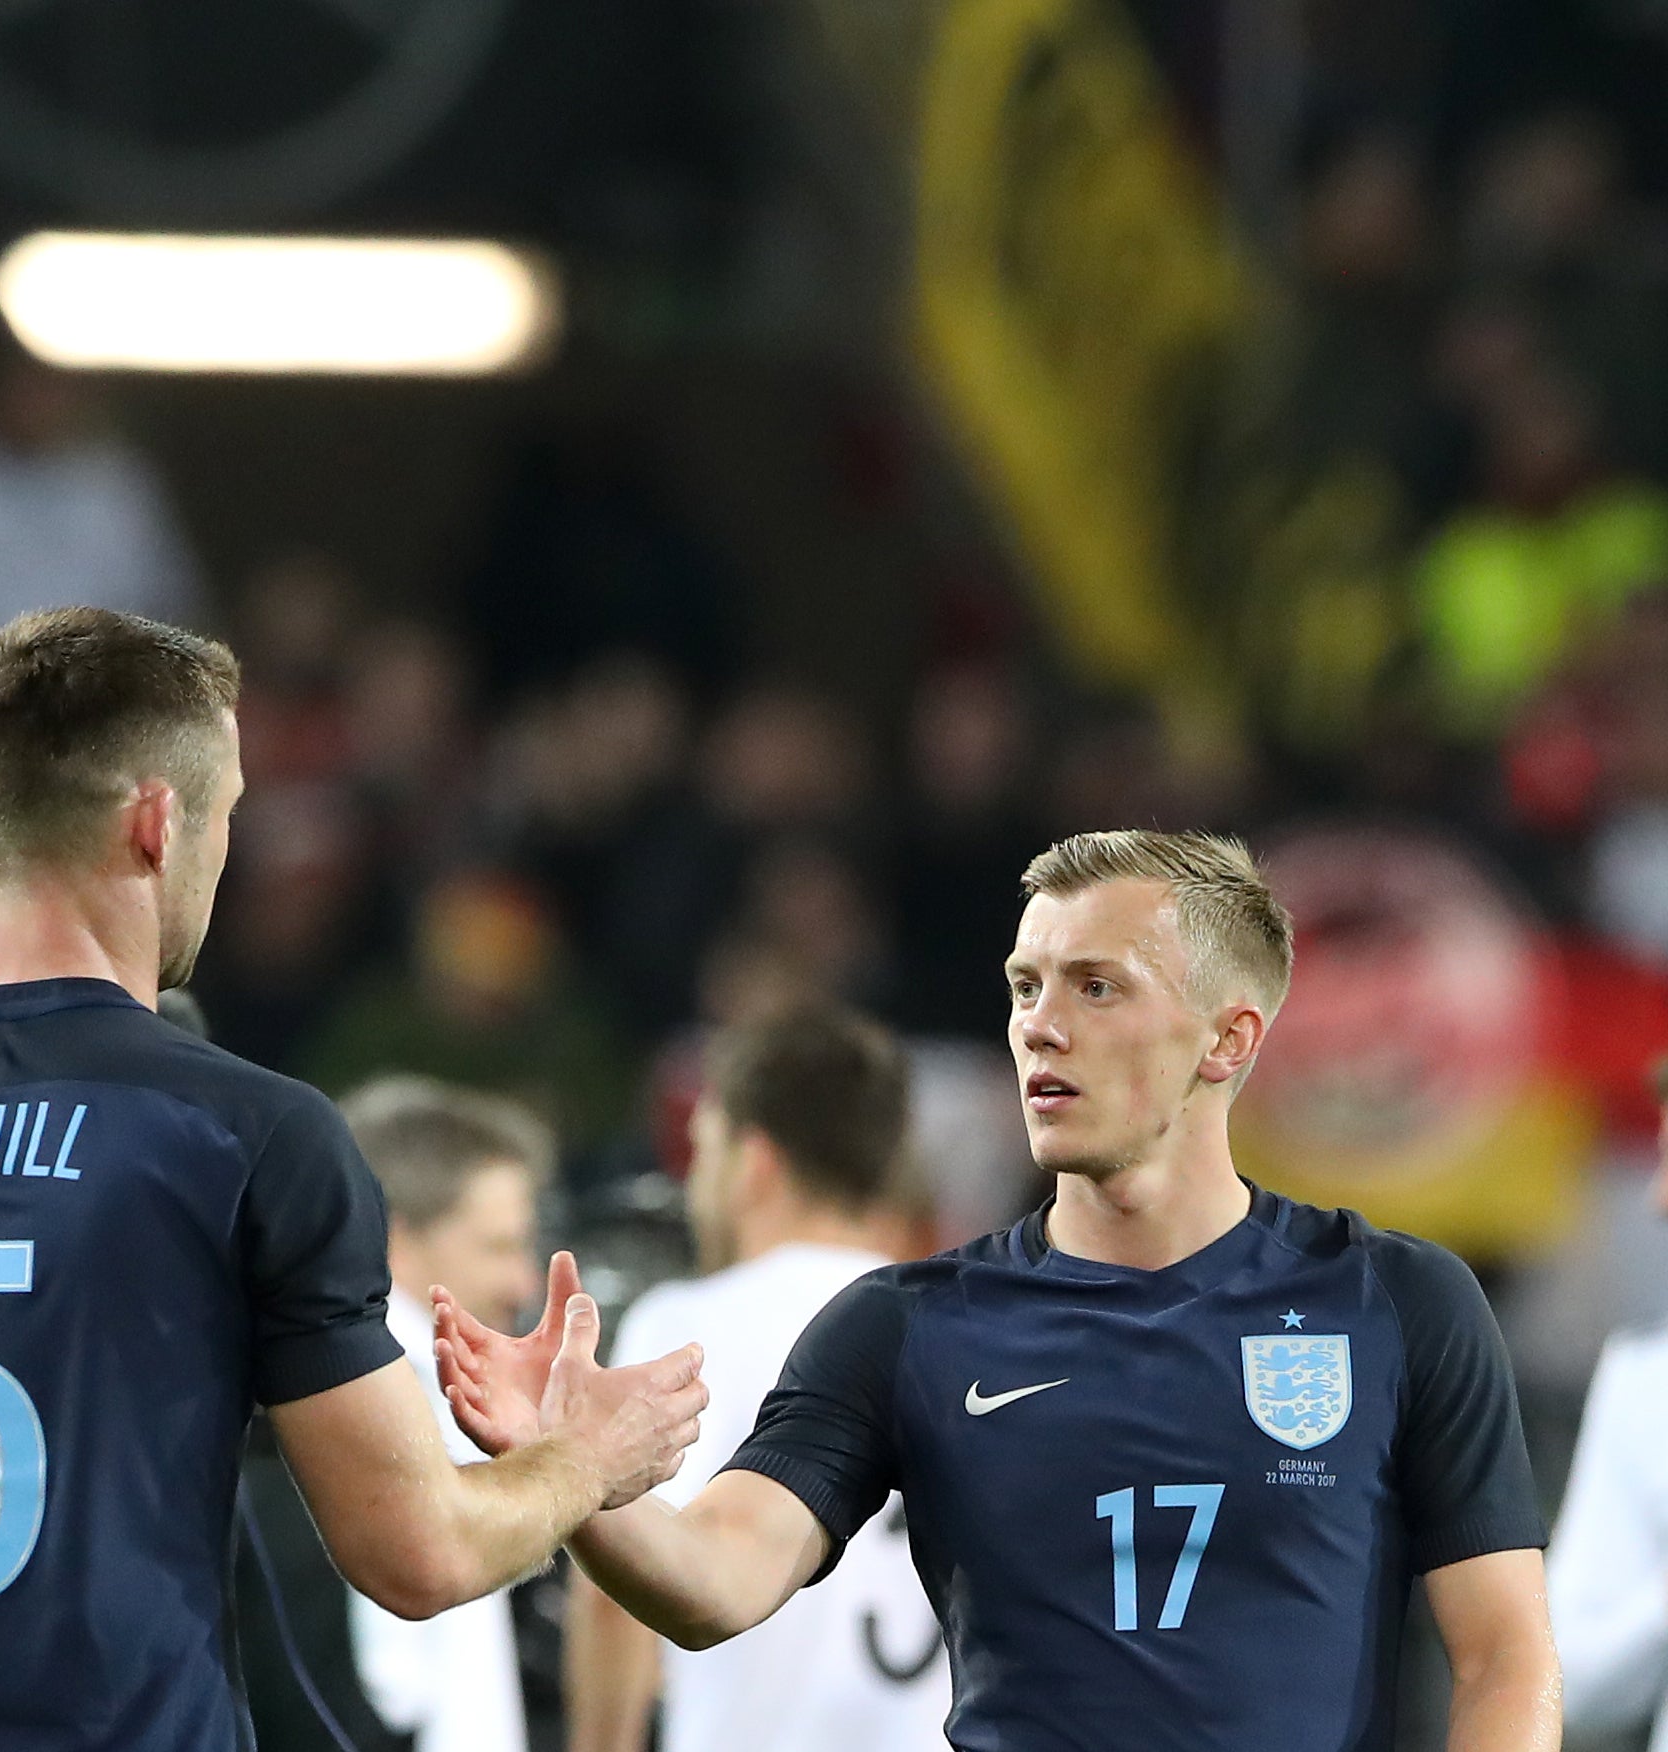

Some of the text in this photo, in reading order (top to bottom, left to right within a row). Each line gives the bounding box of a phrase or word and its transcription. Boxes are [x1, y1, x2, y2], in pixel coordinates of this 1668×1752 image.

[1278, 1459, 1326, 1472] GERMANY
[1265, 1472, 1336, 1487] 22 MARCH 2017
[1094, 1483, 1227, 1632] 17
